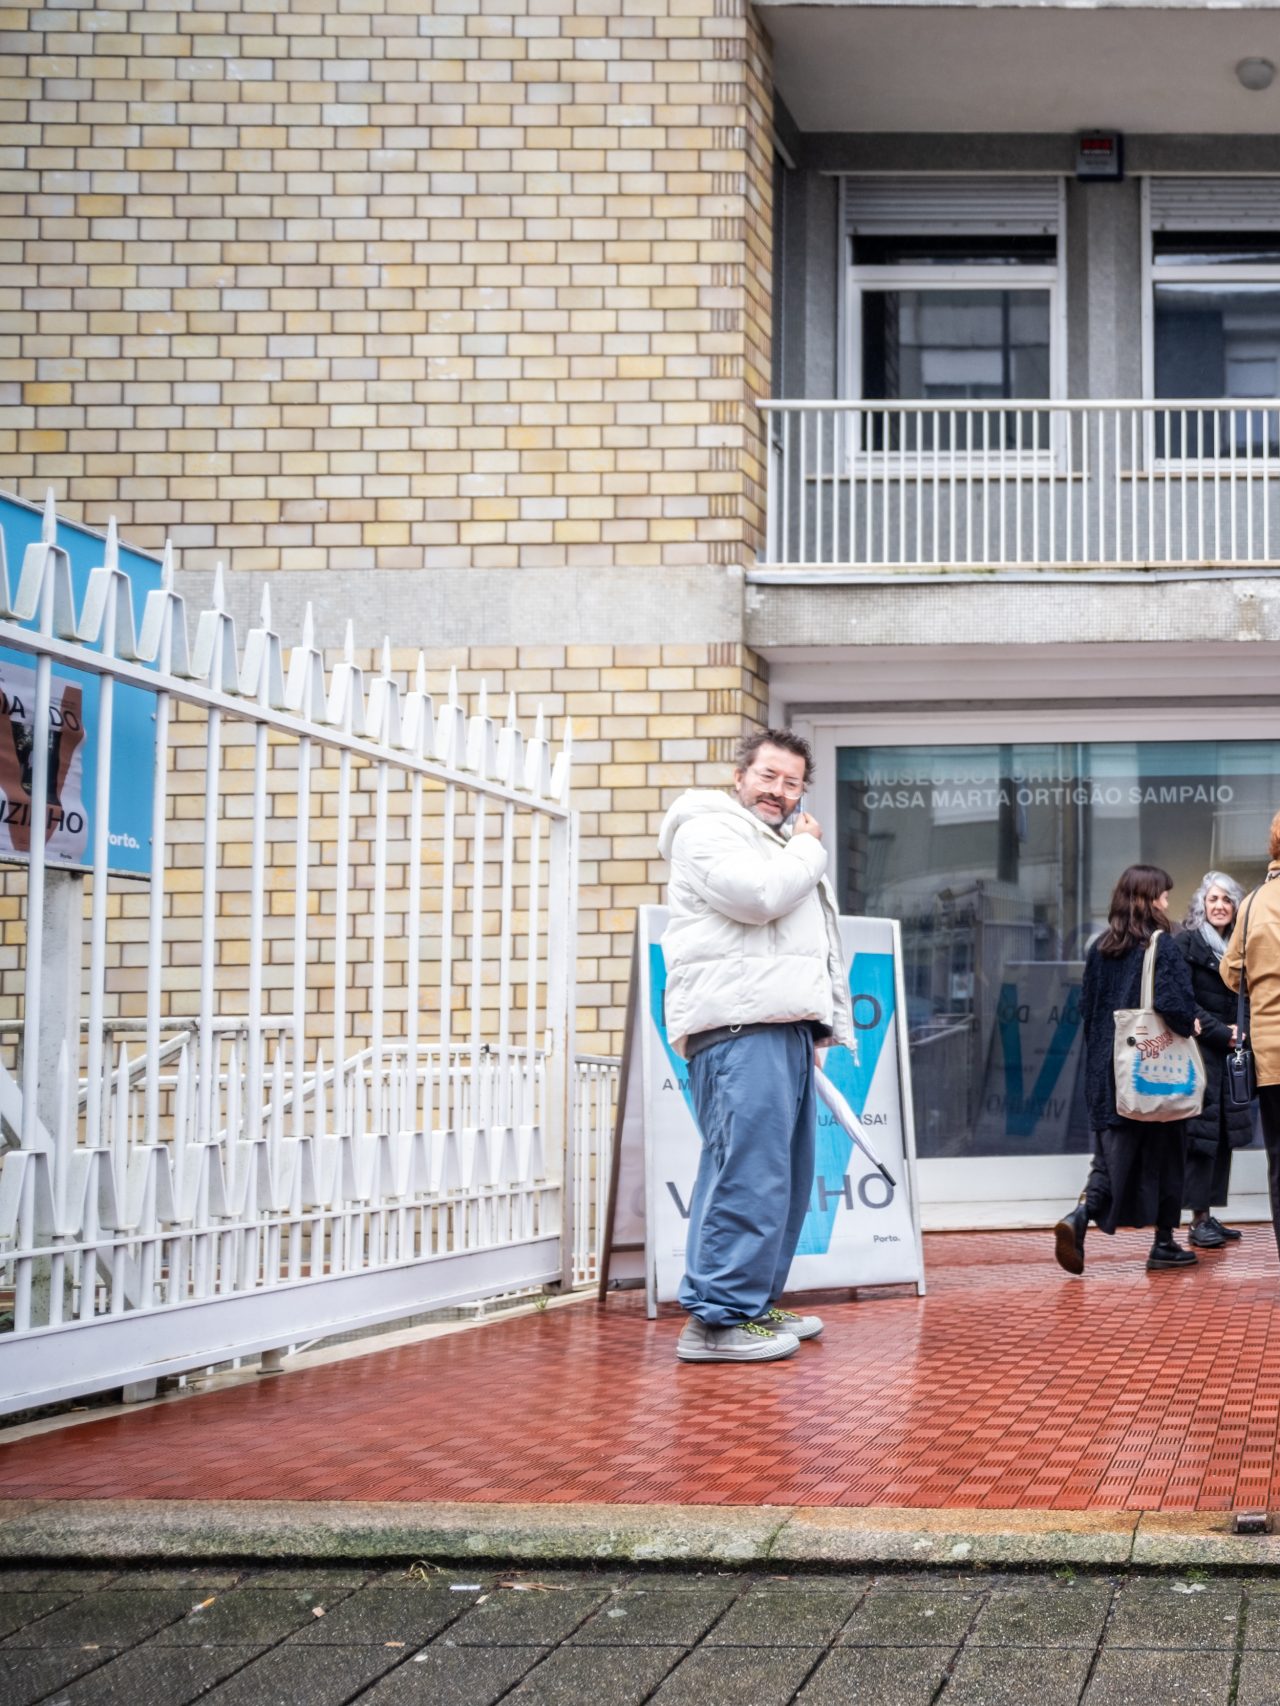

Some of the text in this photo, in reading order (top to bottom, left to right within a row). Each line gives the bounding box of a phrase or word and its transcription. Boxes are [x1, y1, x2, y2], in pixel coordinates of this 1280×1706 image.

[863, 768, 945, 787] MUSEU
[862, 783, 1234, 810] CASA MARTA ORTIGÃO SAMPAIO
[109, 832, 140, 849] orto.
